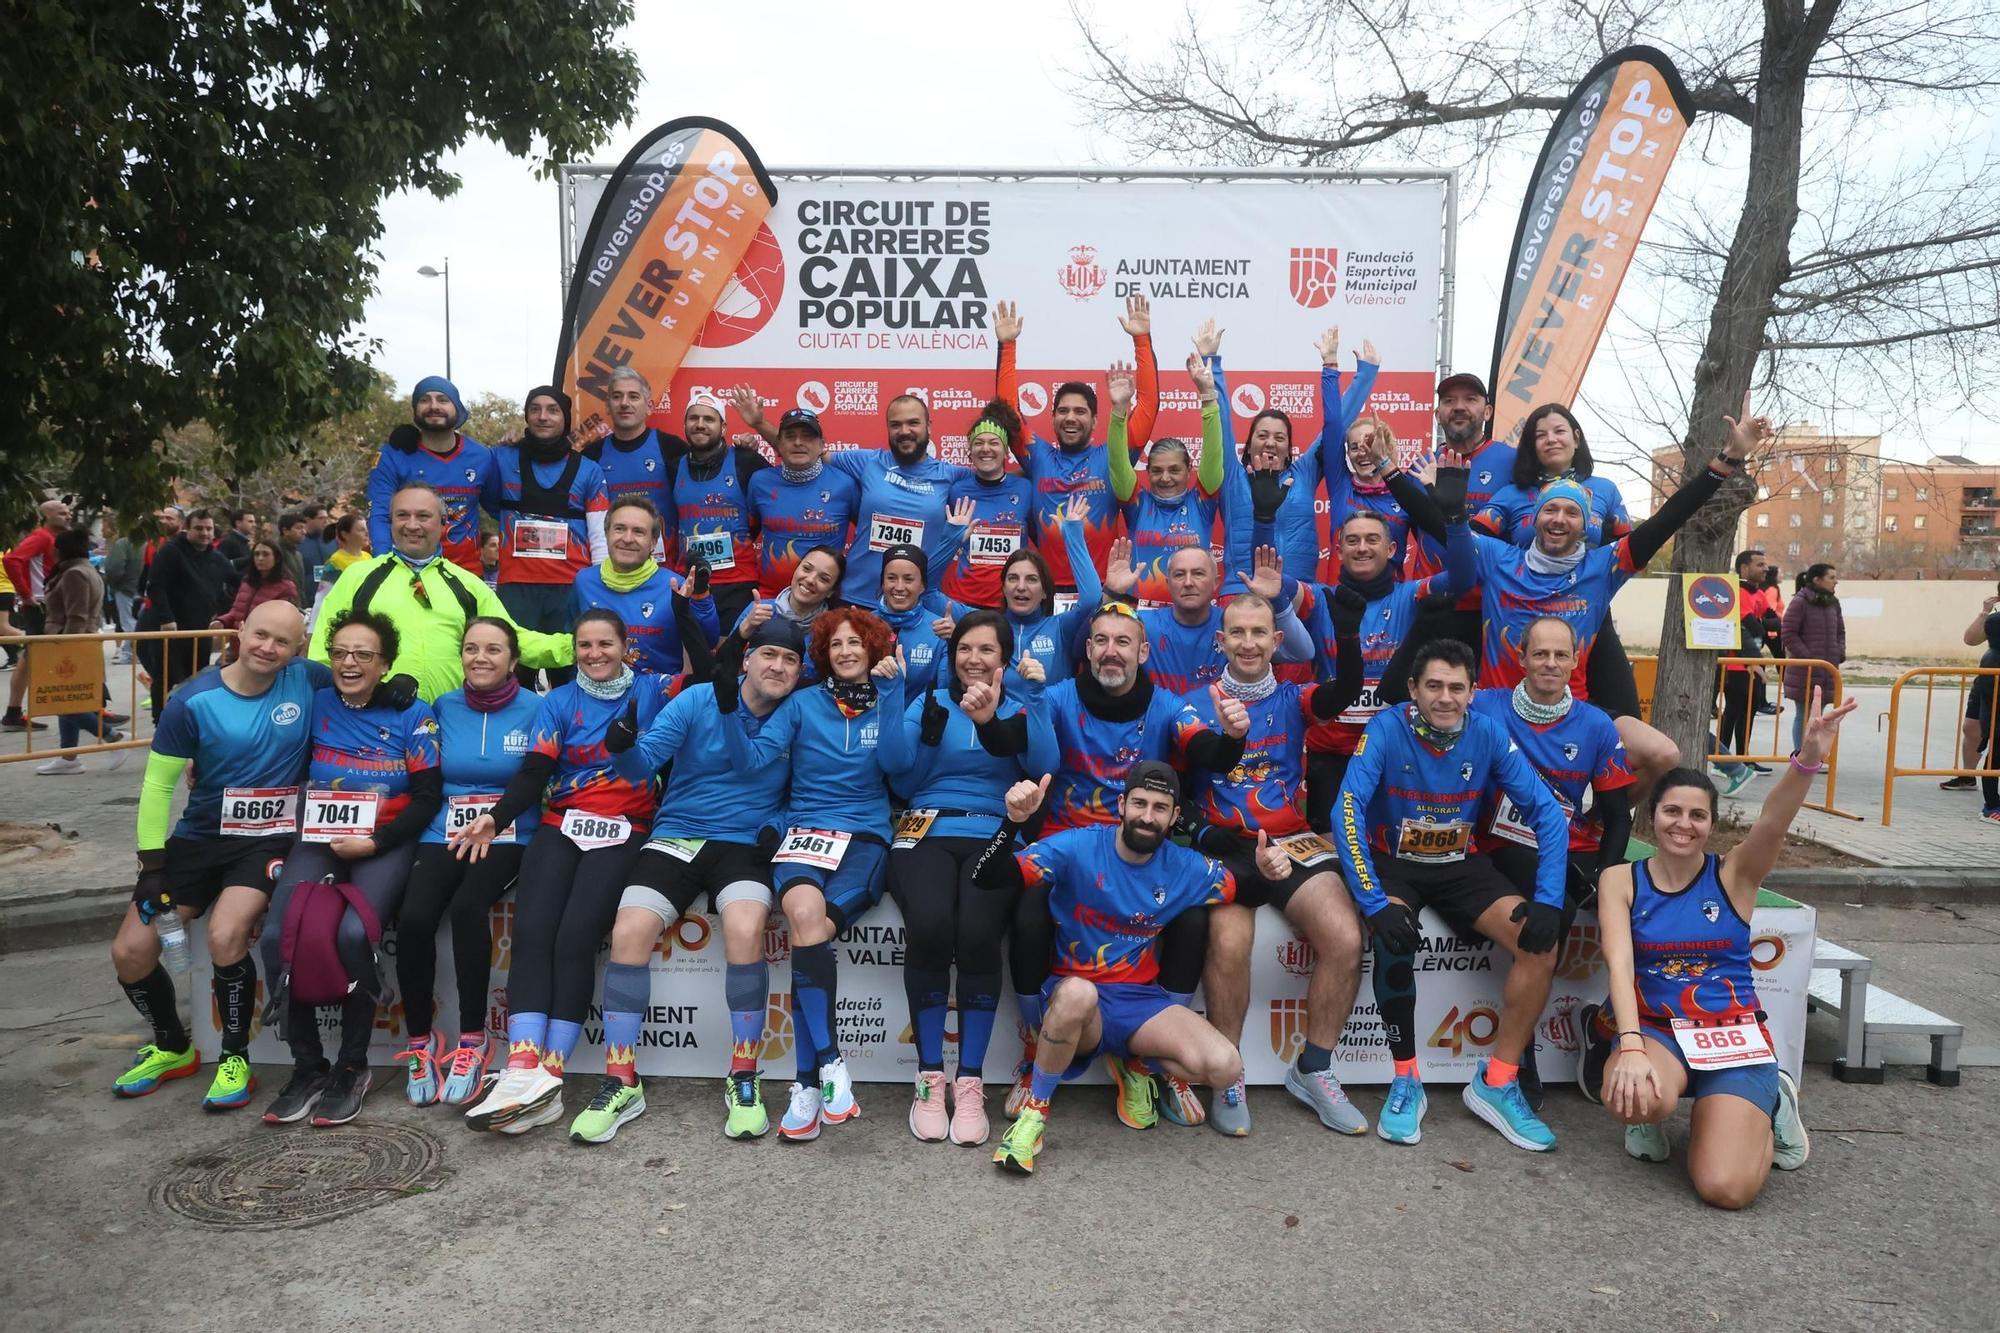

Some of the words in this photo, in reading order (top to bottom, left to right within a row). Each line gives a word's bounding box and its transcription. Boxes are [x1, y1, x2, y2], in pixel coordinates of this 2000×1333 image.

[1516, 92, 1601, 281] neverstop.es
[587, 140, 684, 288] neverstop.es
[798, 200, 934, 227] CIRCUIT
[946, 200, 991, 227] DE
[1577, 107, 1673, 310] RUNNING
[798, 228, 990, 256] CARRERES
[1504, 232, 1598, 403] NEVER
[1580, 79, 1656, 225] STOP
[660, 183, 758, 330] RUNNING
[1345, 251, 1414, 264] Fundació
[576, 258, 684, 400] NEVER
[663, 149, 738, 260] STOP
[1116, 259, 1251, 276] AJUNTAMENT
[1345, 266, 1416, 280] Esportiva
[798, 257, 989, 299] CAIXA
[1345, 279, 1418, 293] Municipal
[1115, 282, 1145, 299] DE
[1150, 277, 1250, 299] VALÈNCIA
[1344, 293, 1407, 306] València
[799, 299, 988, 329] POPULAR
[798, 333, 863, 350] CIUTAT
[866, 333, 891, 350] DE
[895, 330, 989, 351] VALÈNCIA
[834, 394, 878, 404] CAIXA
[932, 387, 973, 399] caixa
[1159, 389, 1199, 400] caixa
[1269, 397, 1313, 407] CAIXA
[1370, 391, 1411, 401] caixa
[834, 403, 878, 411] POPULAR
[1371, 401, 1433, 413] popular
[877, 525, 912, 544] 7346
[978, 537, 1011, 553] 7453
[910, 648, 933, 659] XUFA
[1031, 638, 1053, 650] XUFA
[503, 735, 529, 746] XUFA
[1242, 750, 1269, 760] ORAYA
[232, 799, 286, 820] 6662
[317, 803, 360, 824] 7041
[1416, 804, 1461, 814] ALBORAYA
[571, 819, 621, 838] 5888
[788, 836, 835, 855] 5461
[1343, 790, 1375, 891] XUFARUNNERS
[1408, 829, 1458, 848] 3868
[1693, 1030, 1747, 1049] 866
